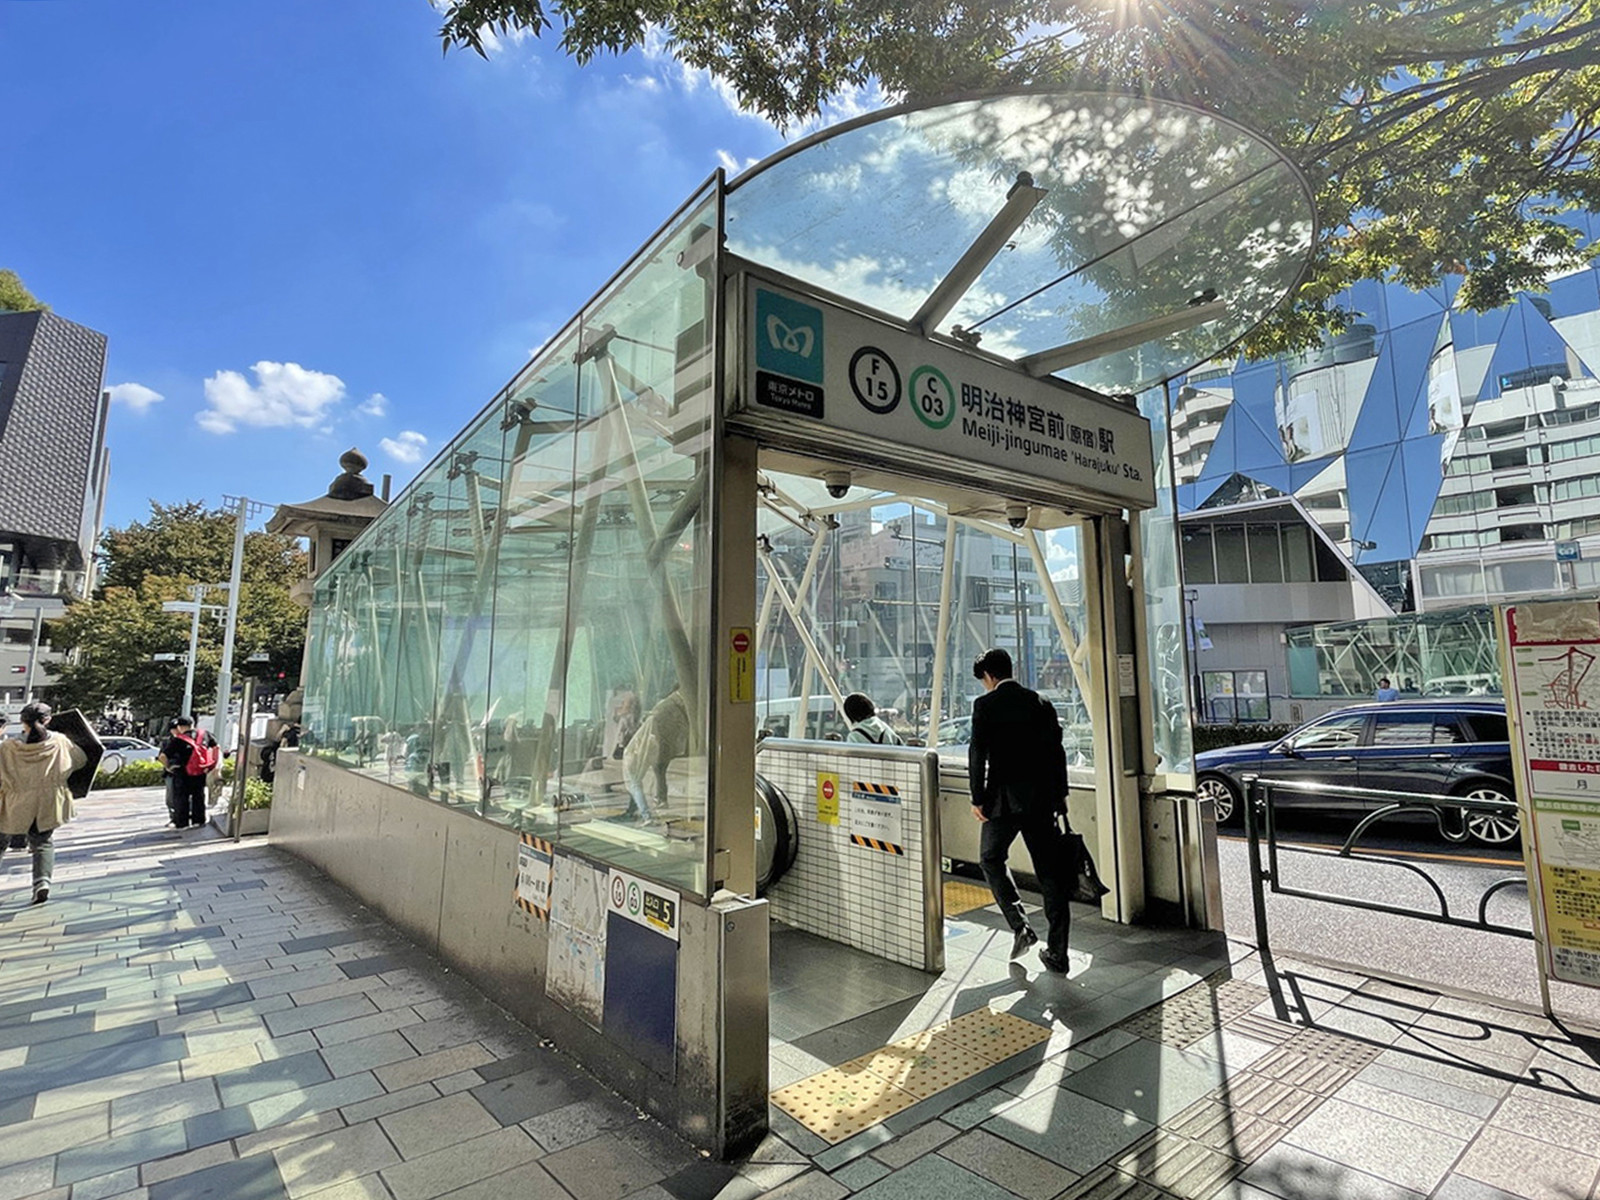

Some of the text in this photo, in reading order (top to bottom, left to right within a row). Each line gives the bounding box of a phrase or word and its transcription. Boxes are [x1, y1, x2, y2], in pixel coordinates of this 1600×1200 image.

[871, 358, 880, 376] F
[866, 377, 888, 400] 15
[927, 377, 937, 394] C
[921, 394, 944, 416] 03
[962, 418, 1068, 462] Meiji-jingumae
[1123, 463, 1143, 482] Sta.
[663, 901, 671, 923] 5
